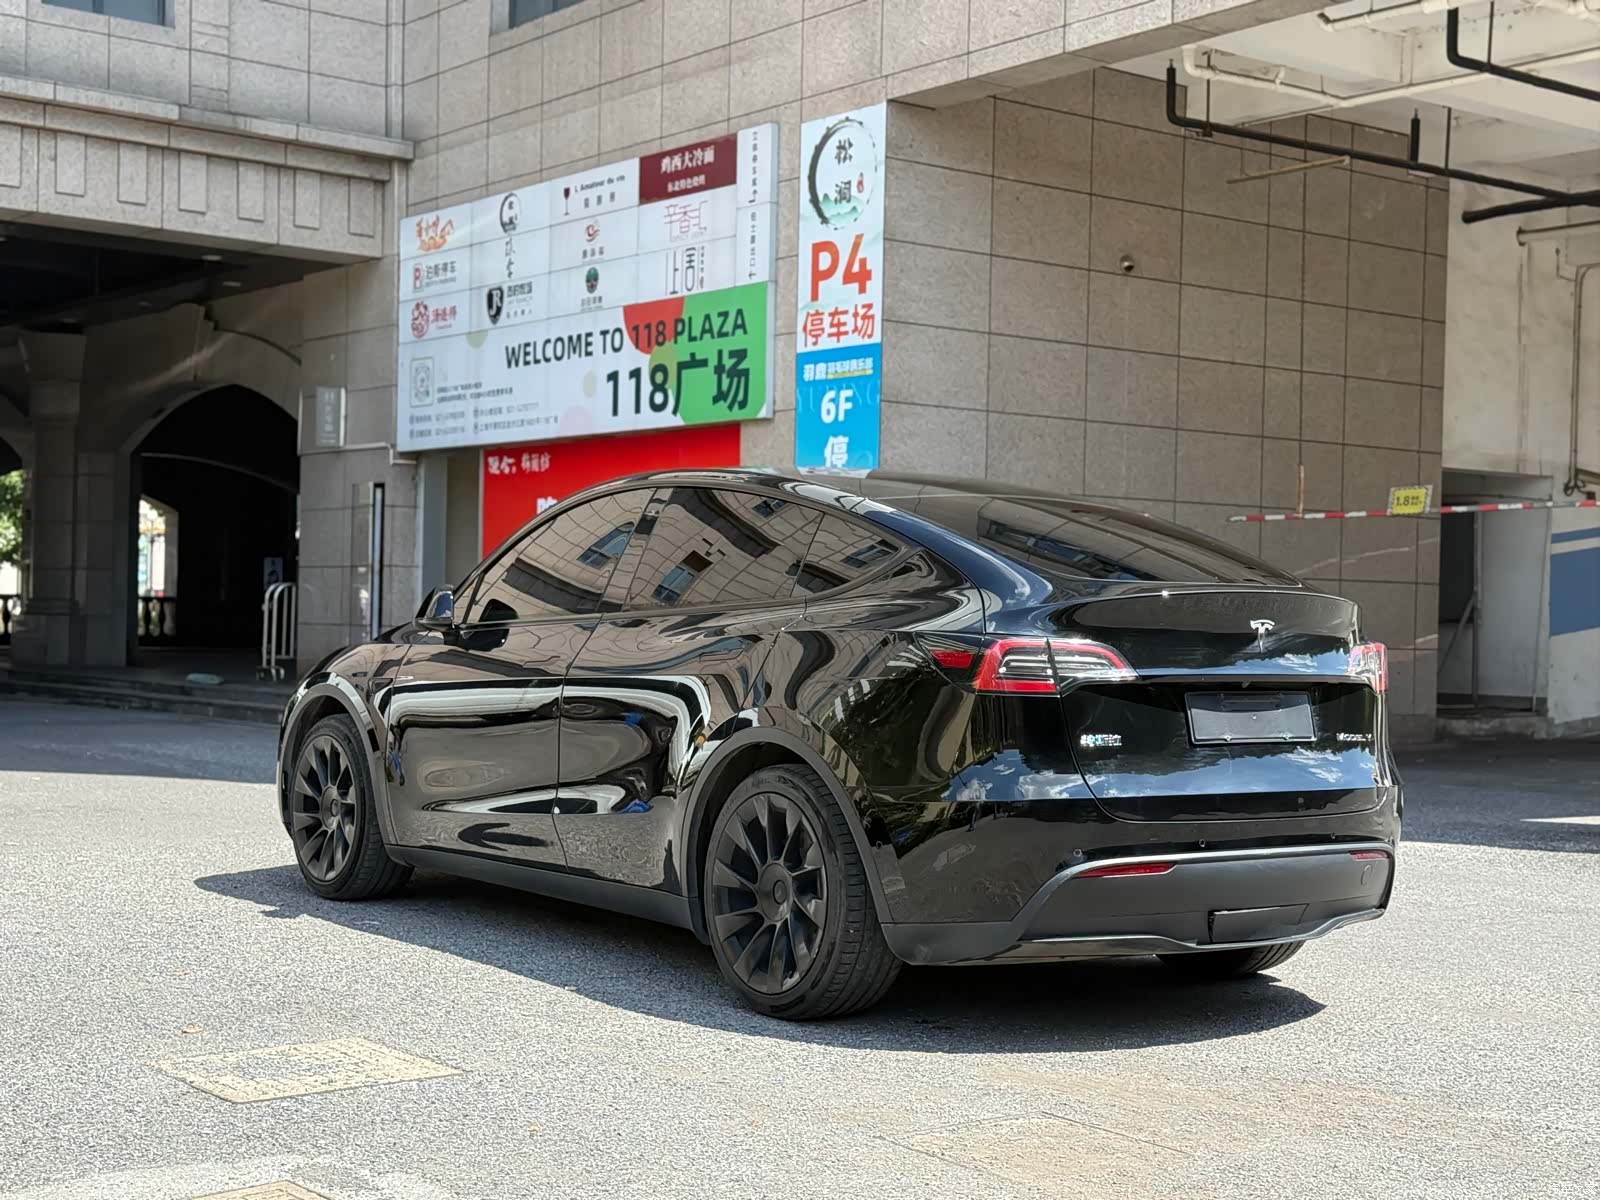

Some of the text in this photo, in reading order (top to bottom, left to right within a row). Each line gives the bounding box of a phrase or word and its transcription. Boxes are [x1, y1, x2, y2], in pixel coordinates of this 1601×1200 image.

[810, 233, 873, 303] P4
[505, 308, 748, 369] WELCOME TO 118 PLAZA
[802, 303, 875, 347] 停车场
[606, 348, 750, 417] 118广场
[820, 389, 854, 424] 6F
